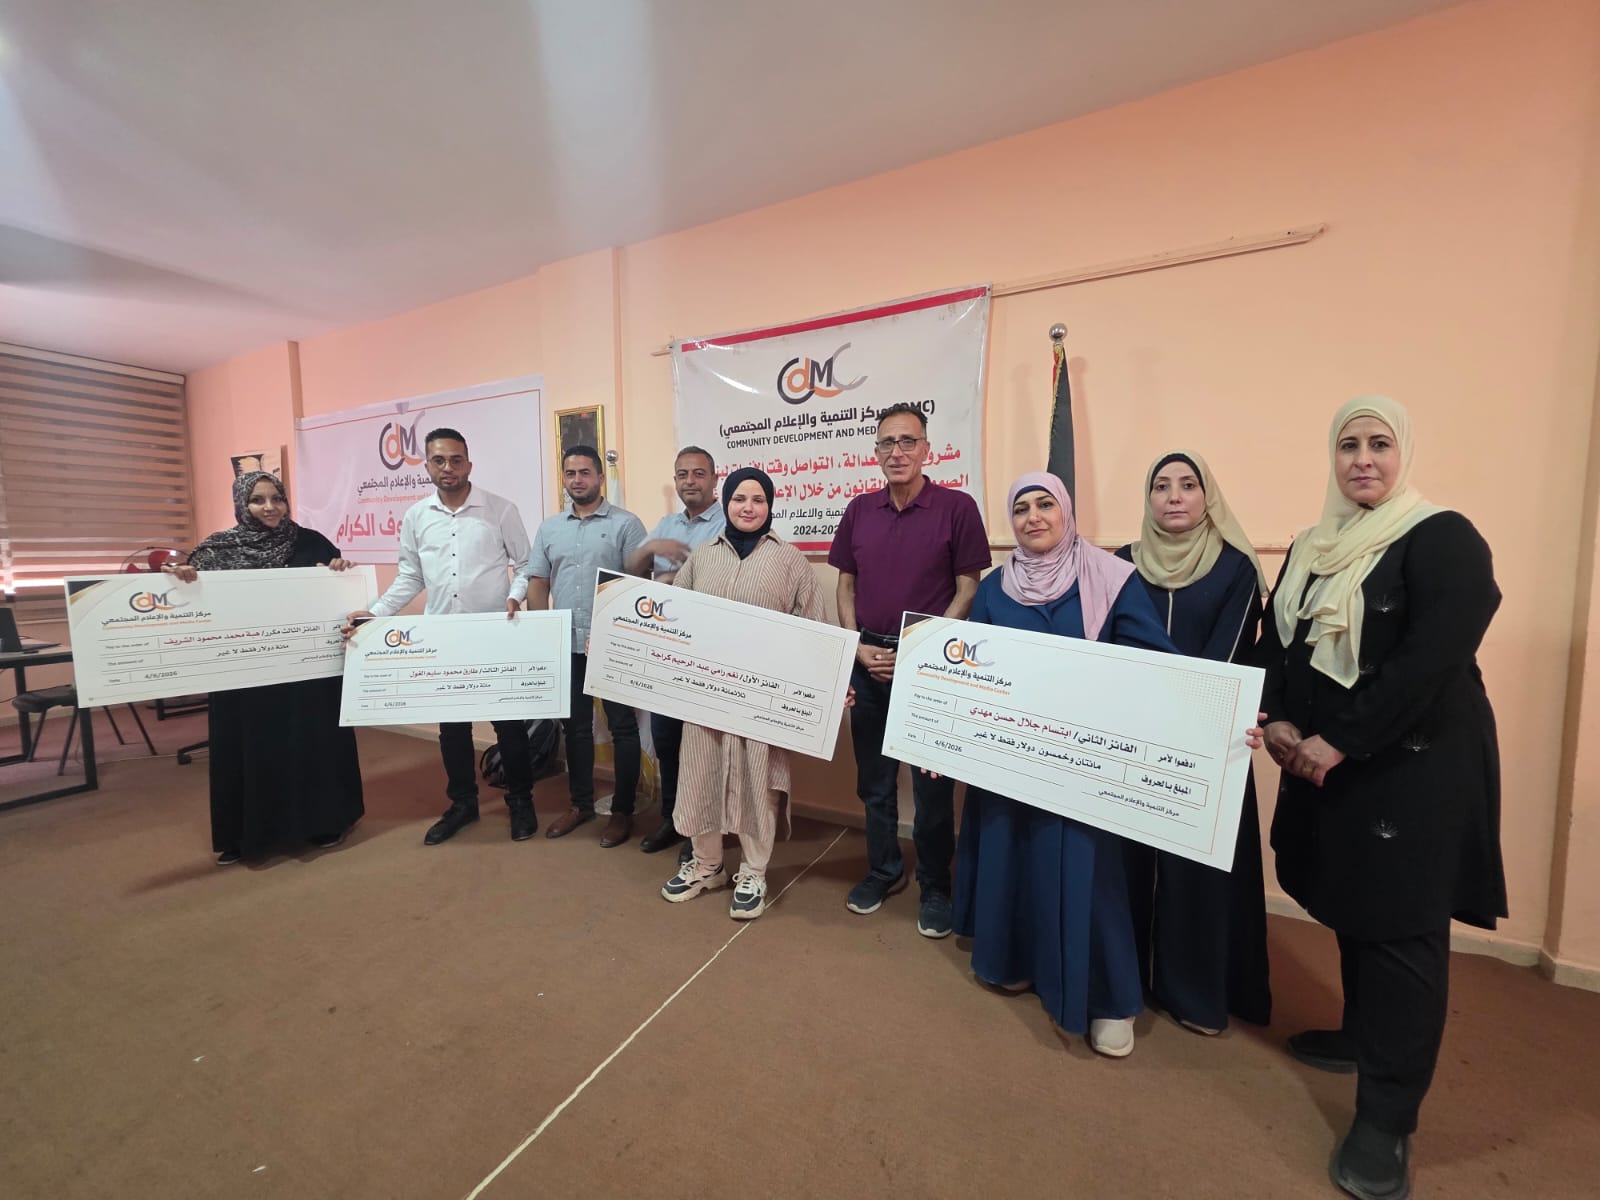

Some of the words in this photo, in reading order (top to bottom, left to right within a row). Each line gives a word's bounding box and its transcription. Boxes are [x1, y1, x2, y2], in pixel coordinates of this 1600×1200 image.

[774, 413, 816, 431] والإعلام
[820, 407, 857, 426] التنمية
[727, 437, 770, 448] COMMUNITY
[773, 430, 833, 444] DEVELOPMENT
[836, 428, 854, 438] AND
[857, 426, 877, 435] MED
[921, 443, 960, 466] مشرو
[767, 459, 788, 476] وقت
[791, 456, 833, 475] التواصل
[358, 476, 388, 496] المجتمعي
[390, 475, 416, 490] والإعلام
[800, 482, 824, 500] خلال
[828, 483, 841, 499] من
[337, 512, 375, 543] الكرام
[918, 662, 947, 672] المجتمعي
[948, 667, 971, 679] والإعلام
[973, 672, 994, 682] التنمية
[995, 679, 1012, 687] مركز
[760, 680, 779, 689] الفائز
[994, 712, 1015, 723] حسن
[1017, 718, 1040, 731] جلال
[974, 730, 987, 739] غير
[1042, 725, 1072, 739] ابتسام
[934, 739, 962, 753] 4/6/2026
[997, 735, 1015, 746] فقط
[1016, 742, 1035, 752] دولار
[1107, 739, 1137, 753] الفائز
[1038, 748, 1074, 764] وخمسون
[1173, 783, 1191, 795] المبلغ
